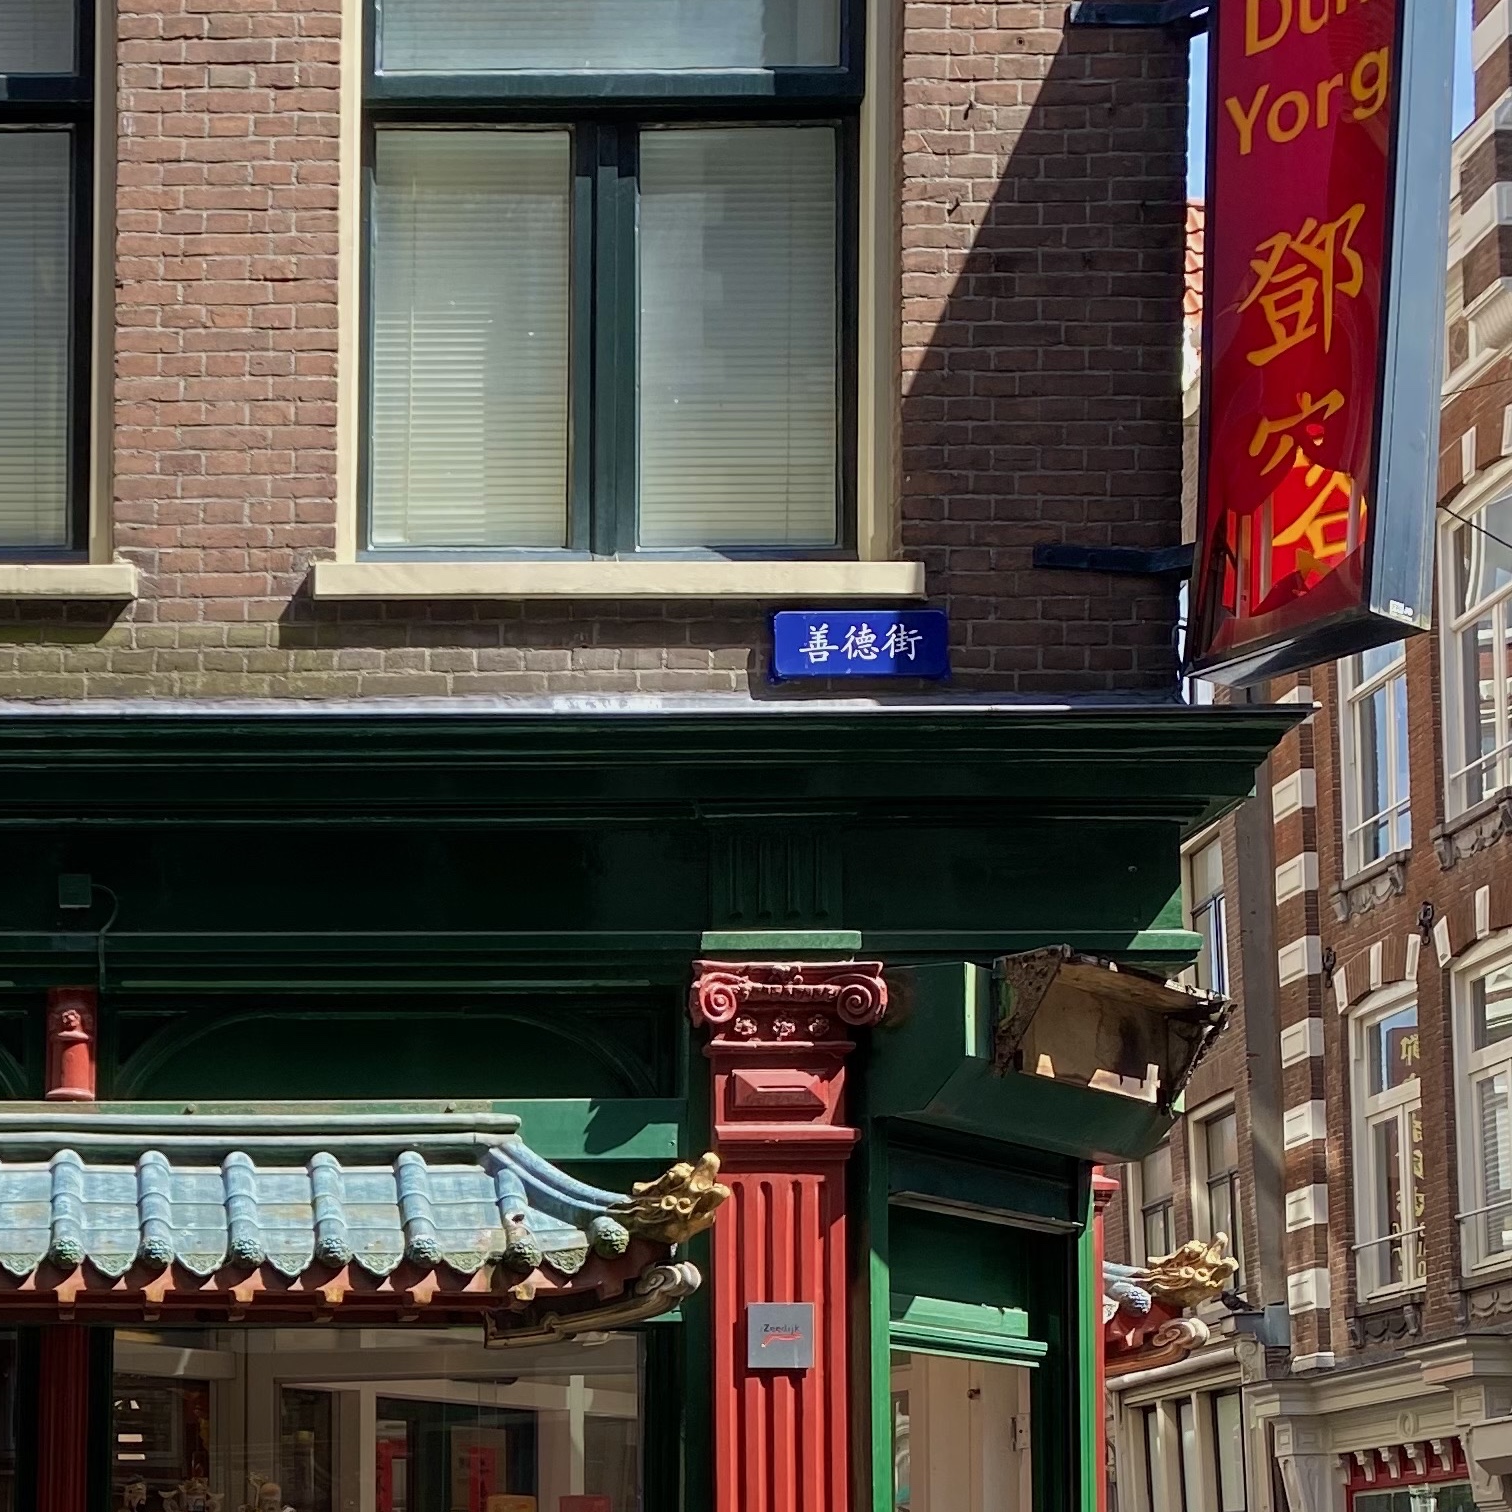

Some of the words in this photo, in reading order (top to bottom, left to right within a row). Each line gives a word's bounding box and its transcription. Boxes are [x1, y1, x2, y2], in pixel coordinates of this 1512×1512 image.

[1245, 0, 1368, 56] Du
[799, 622, 923, 664] 善德街
[763, 1323, 800, 1335] Zeedijk
